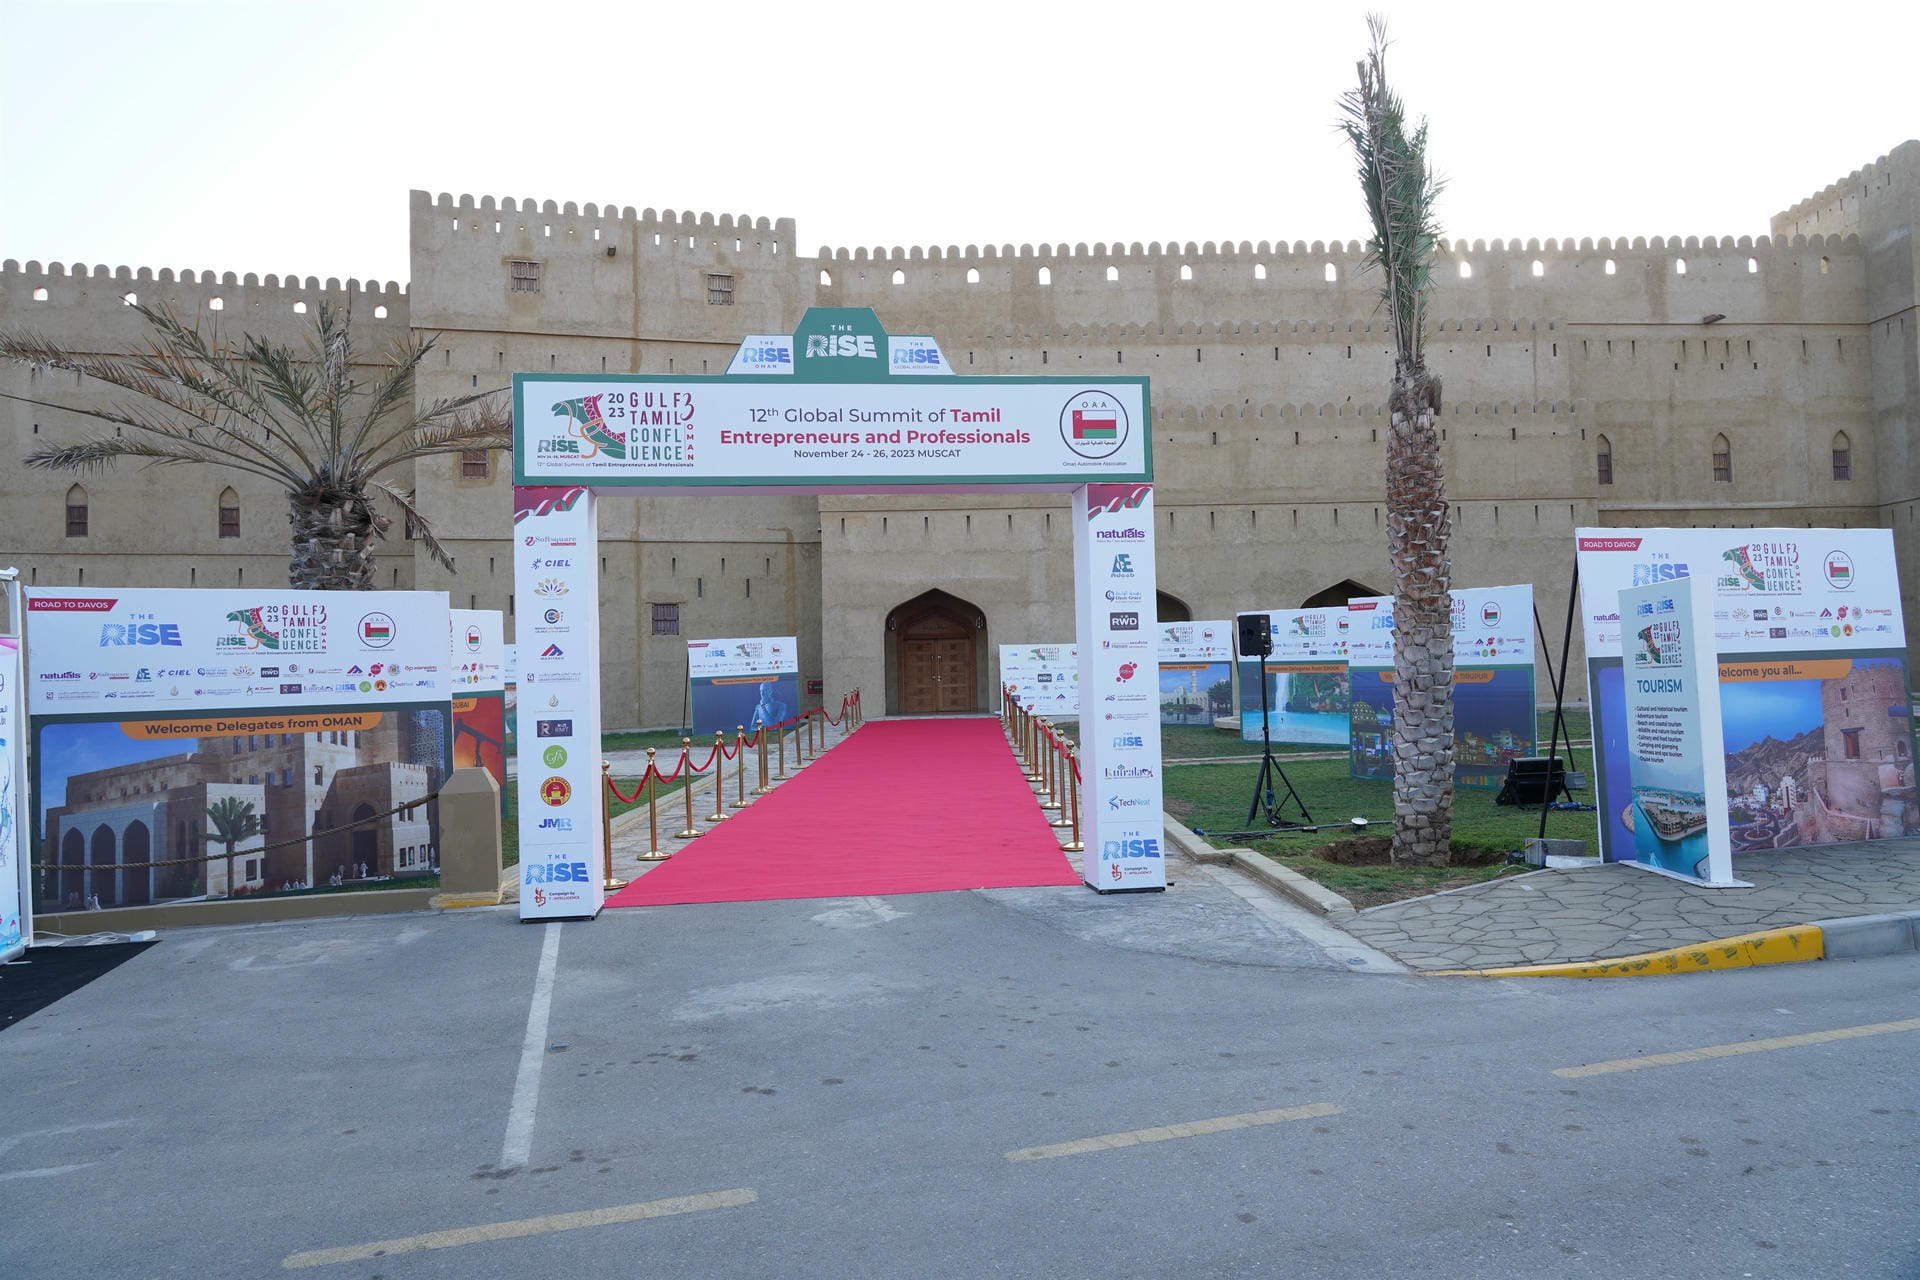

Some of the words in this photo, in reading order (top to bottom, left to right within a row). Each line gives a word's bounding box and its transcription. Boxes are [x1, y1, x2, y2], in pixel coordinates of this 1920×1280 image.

[831, 324, 853, 332] THE
[806, 334, 877, 358] RISE
[742, 348, 791, 364] RISE
[893, 348, 940, 364] RISE
[608, 393, 625, 404] 20
[630, 392, 681, 408] GULF
[608, 408, 625, 418] 23
[630, 411, 681, 425] TAMIL
[749, 408, 779, 422] 12th
[784, 408, 843, 423] Global
[849, 408, 923, 423] Summit
[928, 408, 947, 423] of
[950, 408, 1001, 422] Tamil
[630, 428, 682, 442] CONFL
[720, 430, 860, 447] Entrepreneurs
[865, 430, 901, 444] and
[907, 430, 1031, 444] Professionals
[538, 440, 580, 454] RISE
[686, 424, 694, 460] OMAN
[631, 446, 682, 460] UENCE
[794, 449, 848, 458] November
[851, 450, 864, 458] 24
[874, 450, 888, 460] 26,
[891, 450, 915, 458] 2023
[918, 450, 961, 458] MUSCAT
[1096, 528, 1146, 538] naturals
[1752, 544, 1761, 552] 20
[1764, 544, 1791, 554] GULF
[1754, 554, 1762, 562] 23
[1765, 556, 1792, 567] TAMIL
[1766, 568, 1794, 579] CONFL
[1718, 578, 1740, 588] RISE
[1768, 580, 1796, 592] UENCE
[282, 605, 318, 616] GULF
[282, 617, 318, 627] TAMIL
[1112, 617, 1137, 626] RWD
[1372, 616, 1396, 630] RIS
[1659, 621, 1676, 632] GULF
[100, 624, 182, 647] RISE
[282, 628, 318, 638] CONFL
[1660, 633, 1676, 642] TAMIL
[216, 637, 246, 646] RISE
[283, 640, 318, 650] UENCE
[705, 650, 725, 658] RISE
[40, 671, 80, 680] naturals
[1762, 668, 1780, 678] you
[1782, 665, 1802, 676] all...
[1637, 679, 1682, 693] TOURISM
[145, 724, 212, 735] Welcome
[217, 720, 284, 732] Delegates
[288, 718, 318, 728] from
[322, 716, 362, 727] OMAN
[1112, 736, 1143, 748] RISE
[538, 818, 572, 829] JMR
[1103, 839, 1160, 860] RISE
[526, 862, 589, 884] RISE
